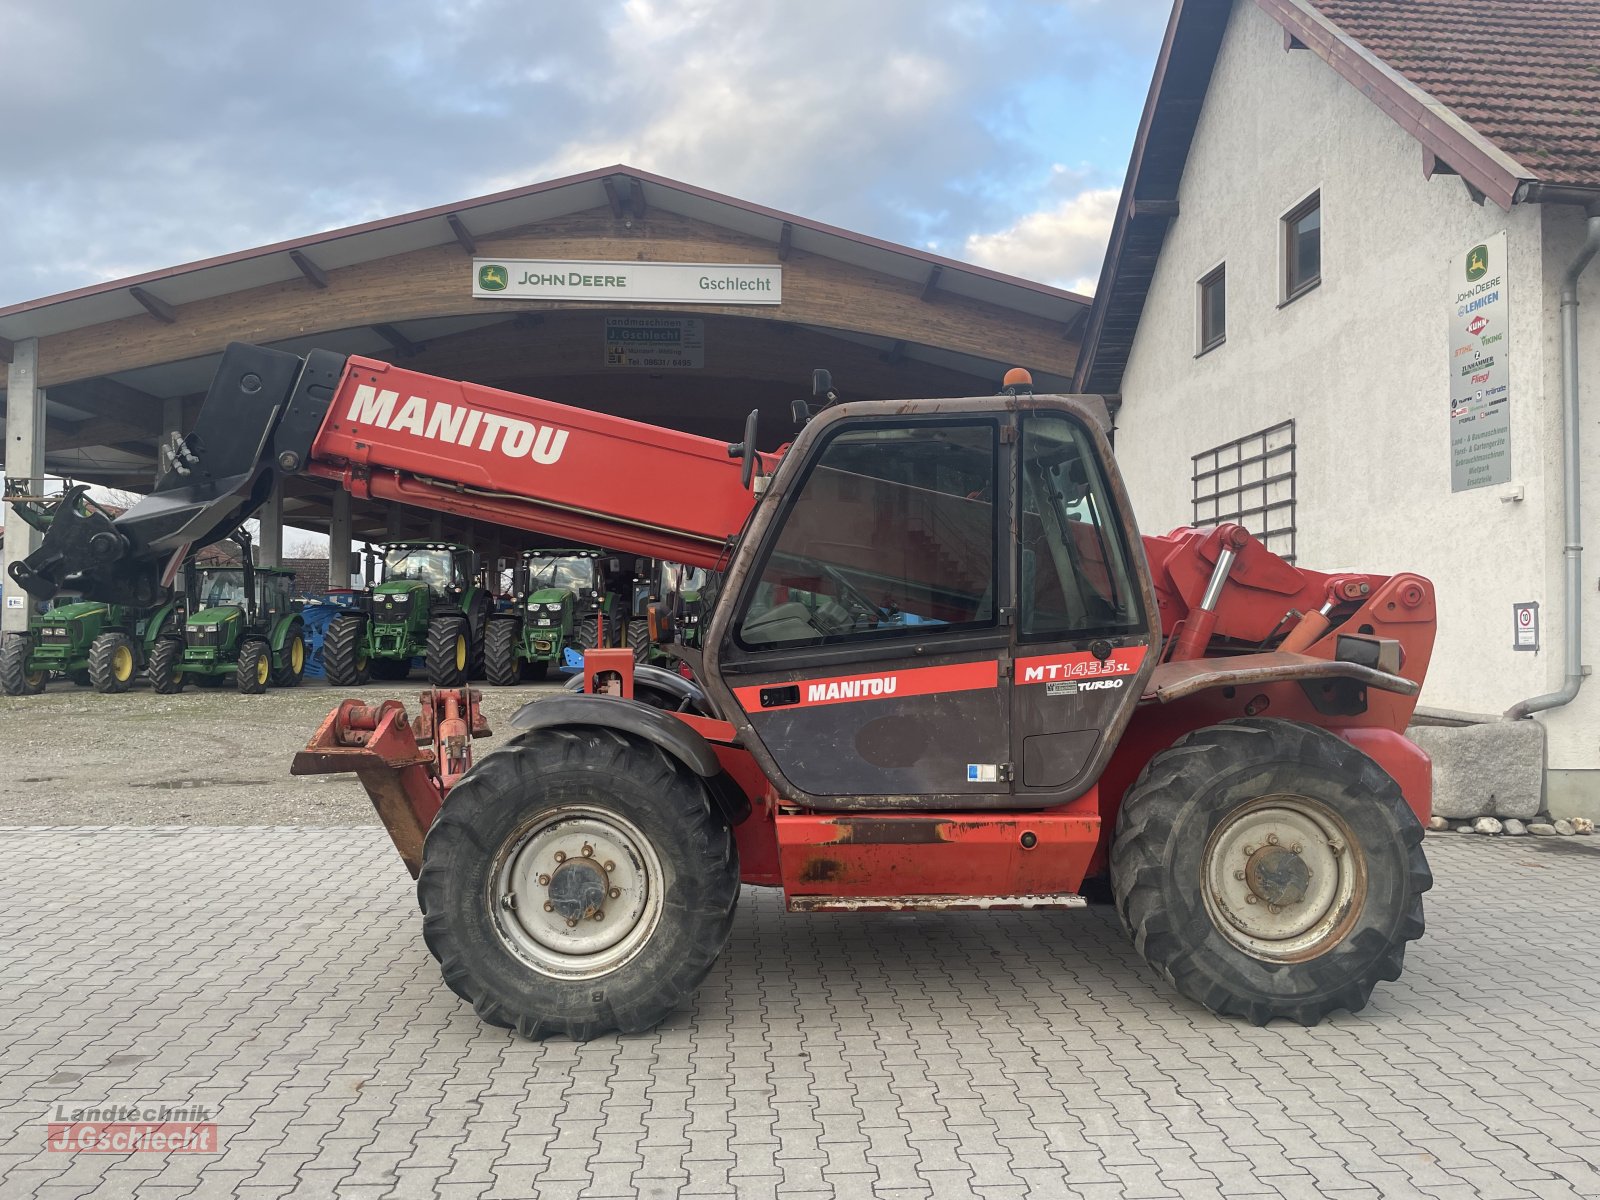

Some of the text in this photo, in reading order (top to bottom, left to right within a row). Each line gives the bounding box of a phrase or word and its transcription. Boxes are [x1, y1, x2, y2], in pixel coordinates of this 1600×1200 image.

[518, 271, 627, 288] JOHN DEERE
[699, 276, 772, 292] Gschlecht
[1455, 276, 1501, 304] JOHN DEERE
[1465, 291, 1499, 314] LEMKEN
[606, 318, 682, 327] Landmaschinen
[1468, 318, 1487, 332] KUHN
[622, 330, 679, 340] Gschlecht
[1481, 333, 1503, 346] VIKING
[346, 384, 570, 465] MANITOU
[808, 676, 897, 702] MANITOU
[1077, 678, 1124, 692] TURBO
